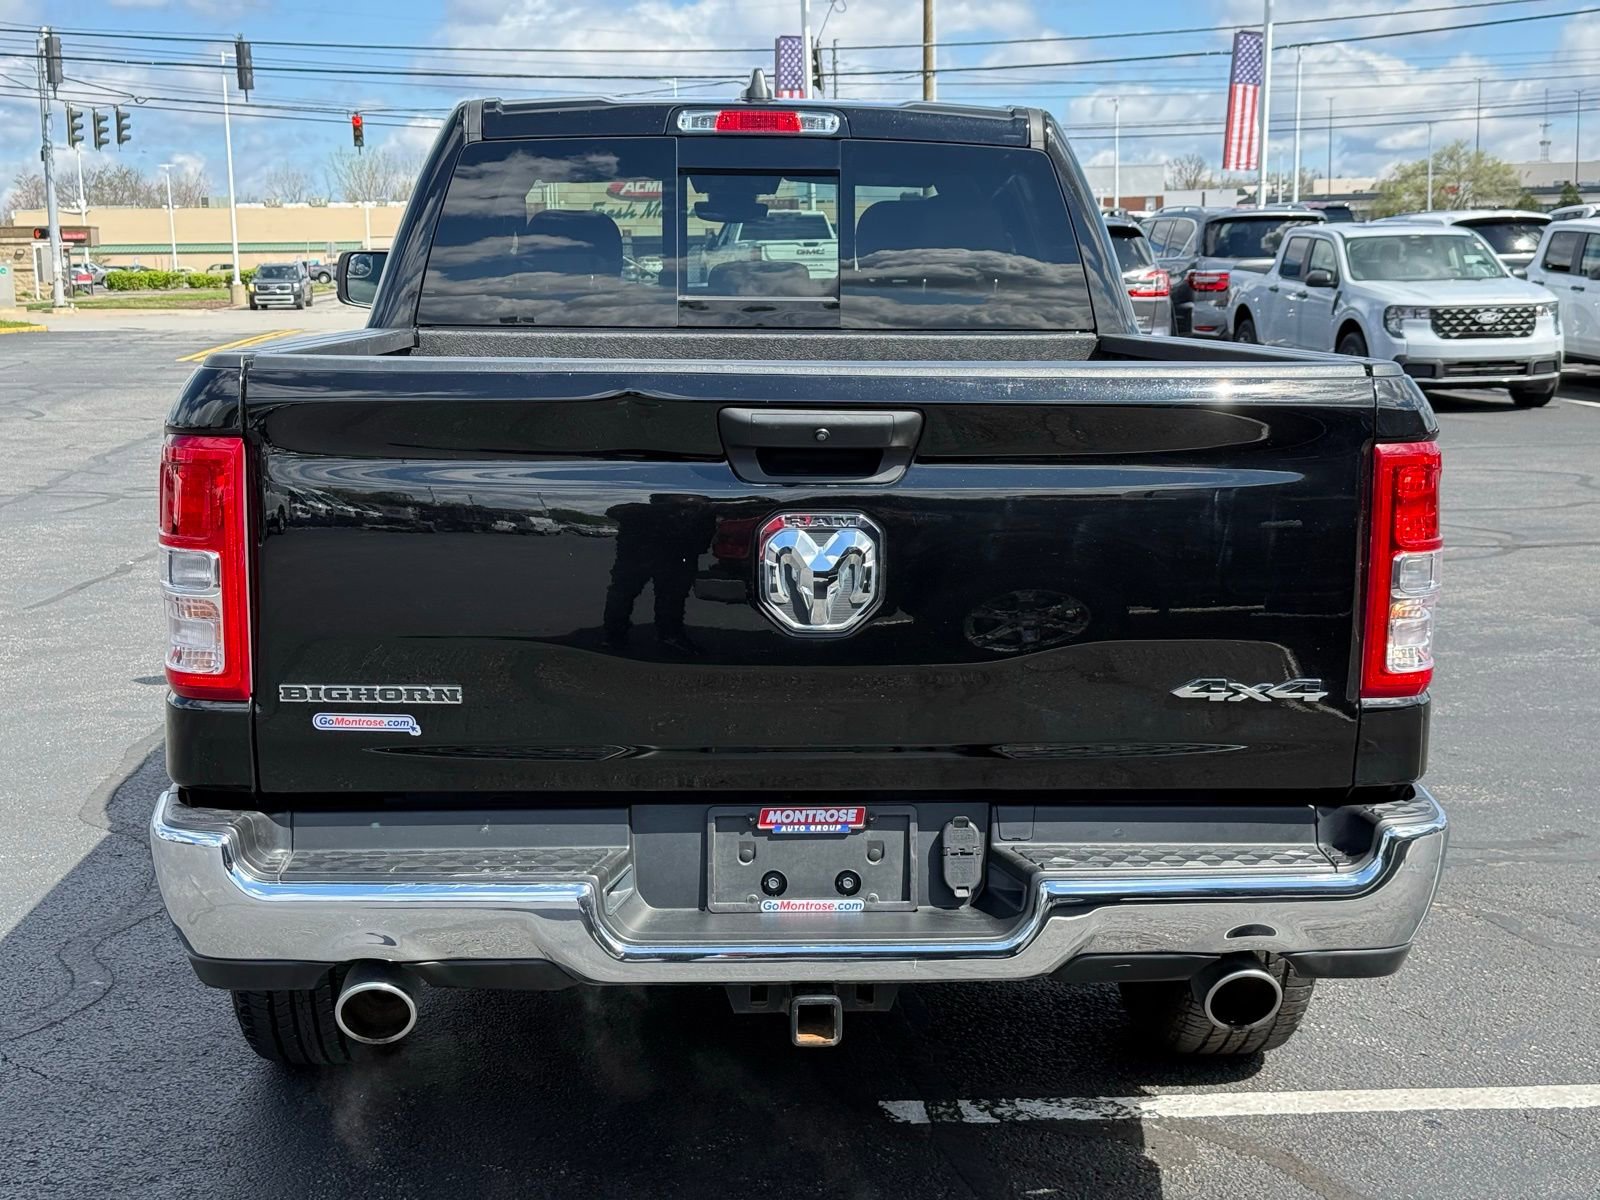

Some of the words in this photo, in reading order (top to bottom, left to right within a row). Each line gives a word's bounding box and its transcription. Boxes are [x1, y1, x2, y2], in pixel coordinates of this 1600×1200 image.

[785, 516, 858, 527] RAM
[279, 685, 463, 704] BIGHORN
[319, 717, 410, 727] GoMontrose.com
[766, 809, 857, 823] MONTROSE
[781, 824, 805, 832] AUTO
[809, 824, 841, 832] GROUP
[763, 900, 862, 911] GoMontrose.com
